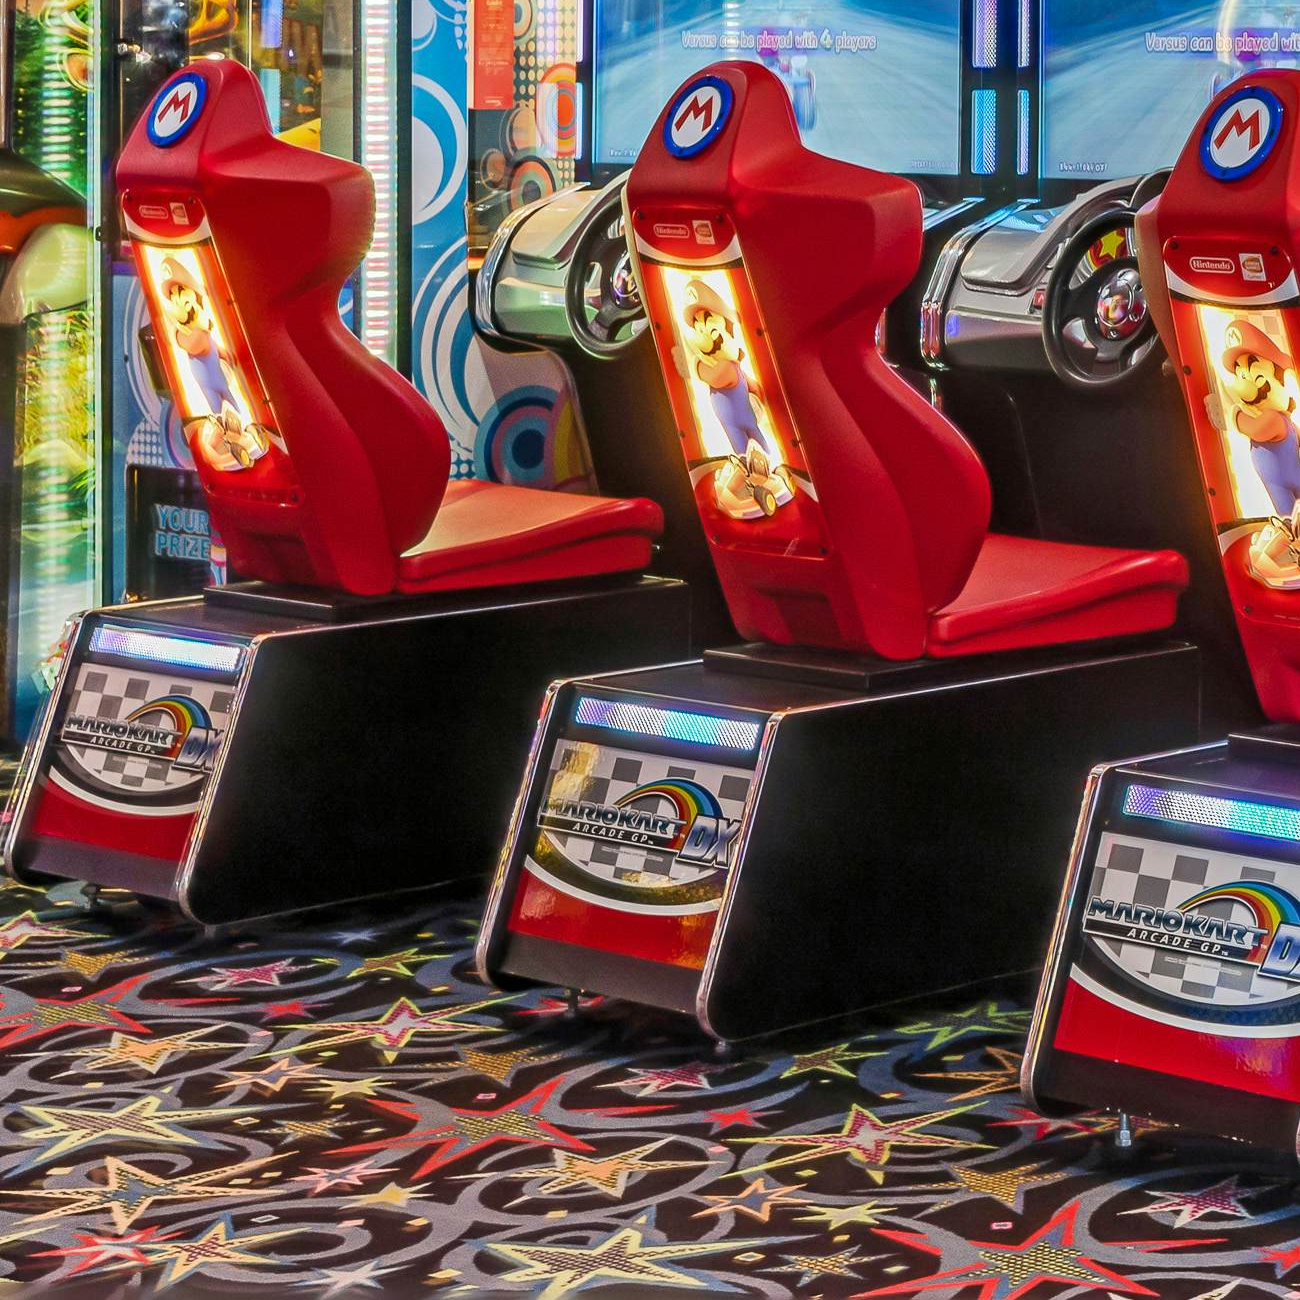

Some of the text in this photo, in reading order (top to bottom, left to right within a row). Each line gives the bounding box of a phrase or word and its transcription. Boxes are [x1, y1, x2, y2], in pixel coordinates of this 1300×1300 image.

[1146, 33, 1187, 51] Versus
[1190, 38, 1213, 51] can
[1216, 33, 1233, 51] be
[1235, 32, 1278, 55] played
[156, 91, 193, 124] M
[678, 93, 717, 134] M
[1218, 110, 1266, 150] M
[154, 503, 209, 536] YOUR
[154, 530, 211, 561] PRIZE
[572, 821, 624, 839] ARCADE
[677, 814, 742, 868] DX
[1126, 928, 1191, 949] ARCADE
